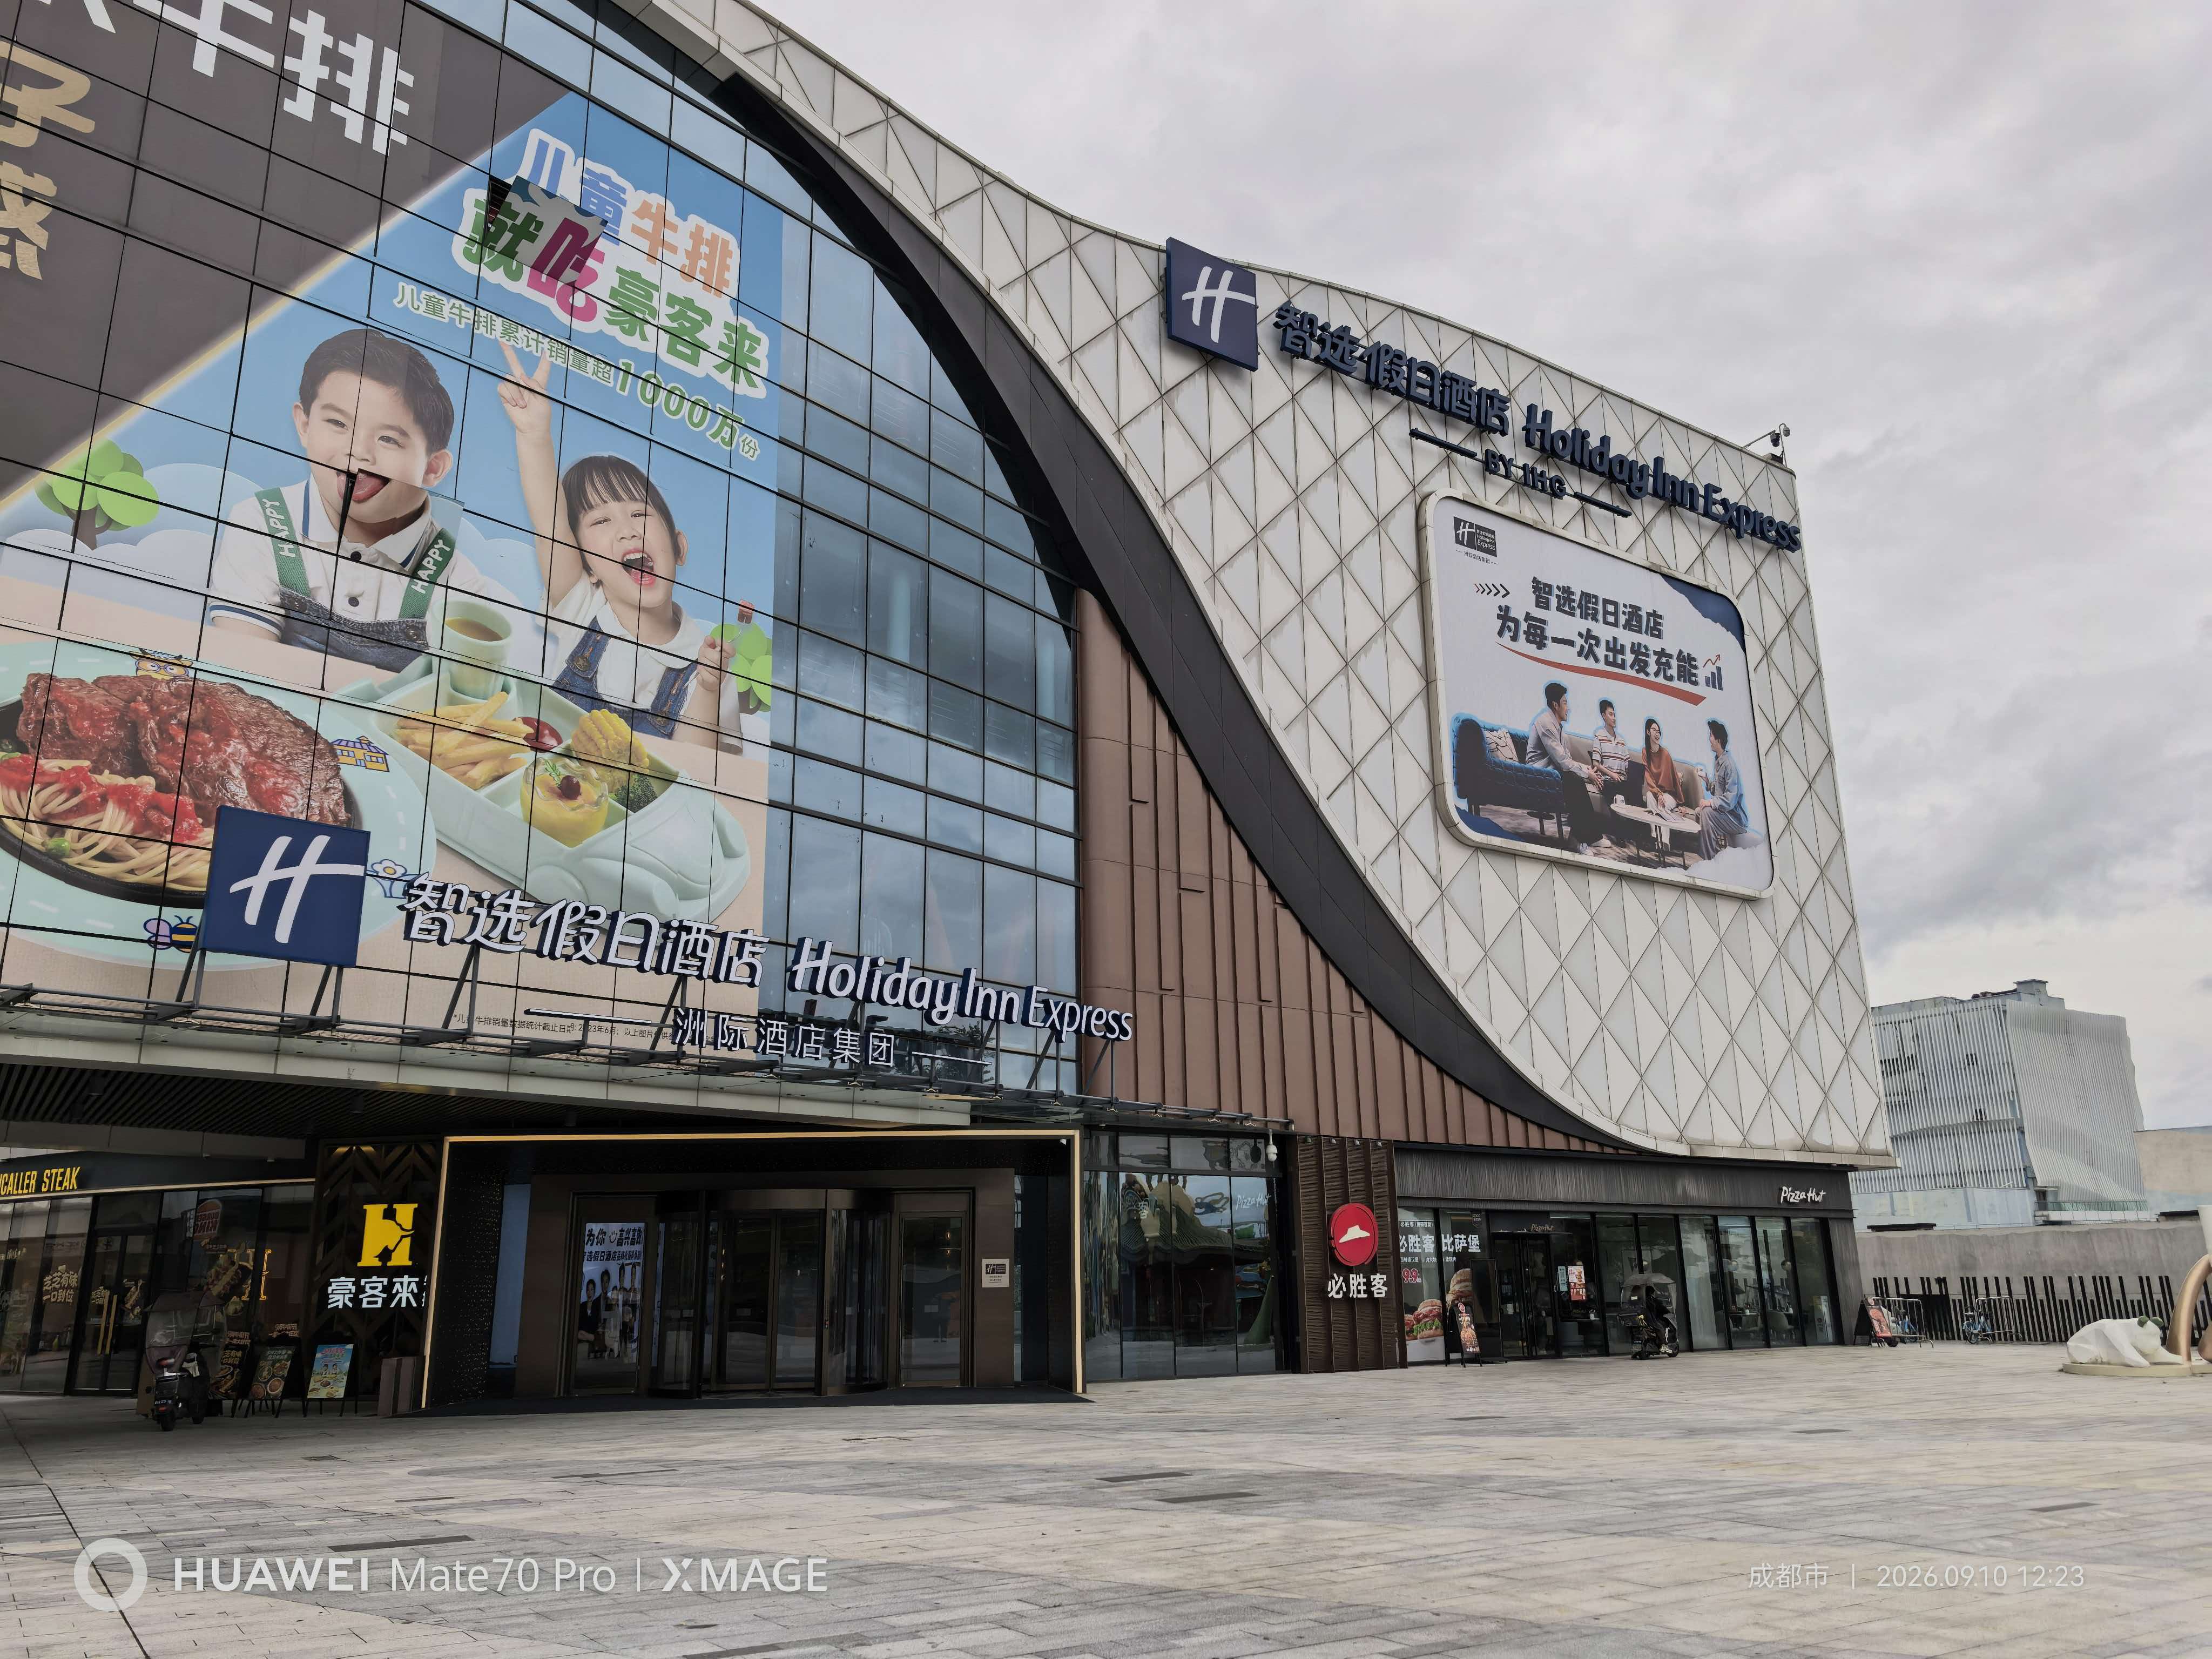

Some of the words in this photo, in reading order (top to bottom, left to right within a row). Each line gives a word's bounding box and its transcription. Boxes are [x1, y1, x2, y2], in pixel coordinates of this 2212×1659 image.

[83, 0, 414, 156] 牛排
[521, 137, 733, 299] 儿童牛排
[462, 197, 763, 389] 就吃豪客来
[1273, 300, 1511, 436] 智选假日酒店
[1484, 448, 1514, 476] BY
[1523, 463, 1568, 500] IHG
[1523, 403, 1649, 500] Holiday
[1652, 456, 1700, 512] Inn
[1703, 483, 1802, 553] Express
[261, 498, 296, 558] HAPPY
[1477, 539, 1495, 551] Express
[411, 538, 451, 595] HAPPY
[1530, 576, 1664, 640] 智选假日酒店
[1496, 604, 1701, 687] 为每一次出发充能
[401, 871, 770, 988] 智选假日酒店
[788, 936, 959, 1026] Holiday
[958, 968, 1021, 1024] Inn
[1022, 985, 1134, 1042] Express
[674, 1007, 895, 1068] 洲际酒店集团
[42, 1166, 81, 1192] STEAK
[1236, 1194, 1256, 1210] Pizza
[1781, 1186, 1806, 1204] Pizza
[1806, 1186, 1826, 1203] Hut
[585, 1228, 607, 1246] 为你
[1399, 1233, 1435, 1253] 必胜客
[1441, 1233, 1481, 1252] 比萨堡
[43, 1289, 75, 1303] 一口到位
[327, 1274, 418, 1309] 豪客來
[1327, 1273, 1388, 1299] 必胜客
